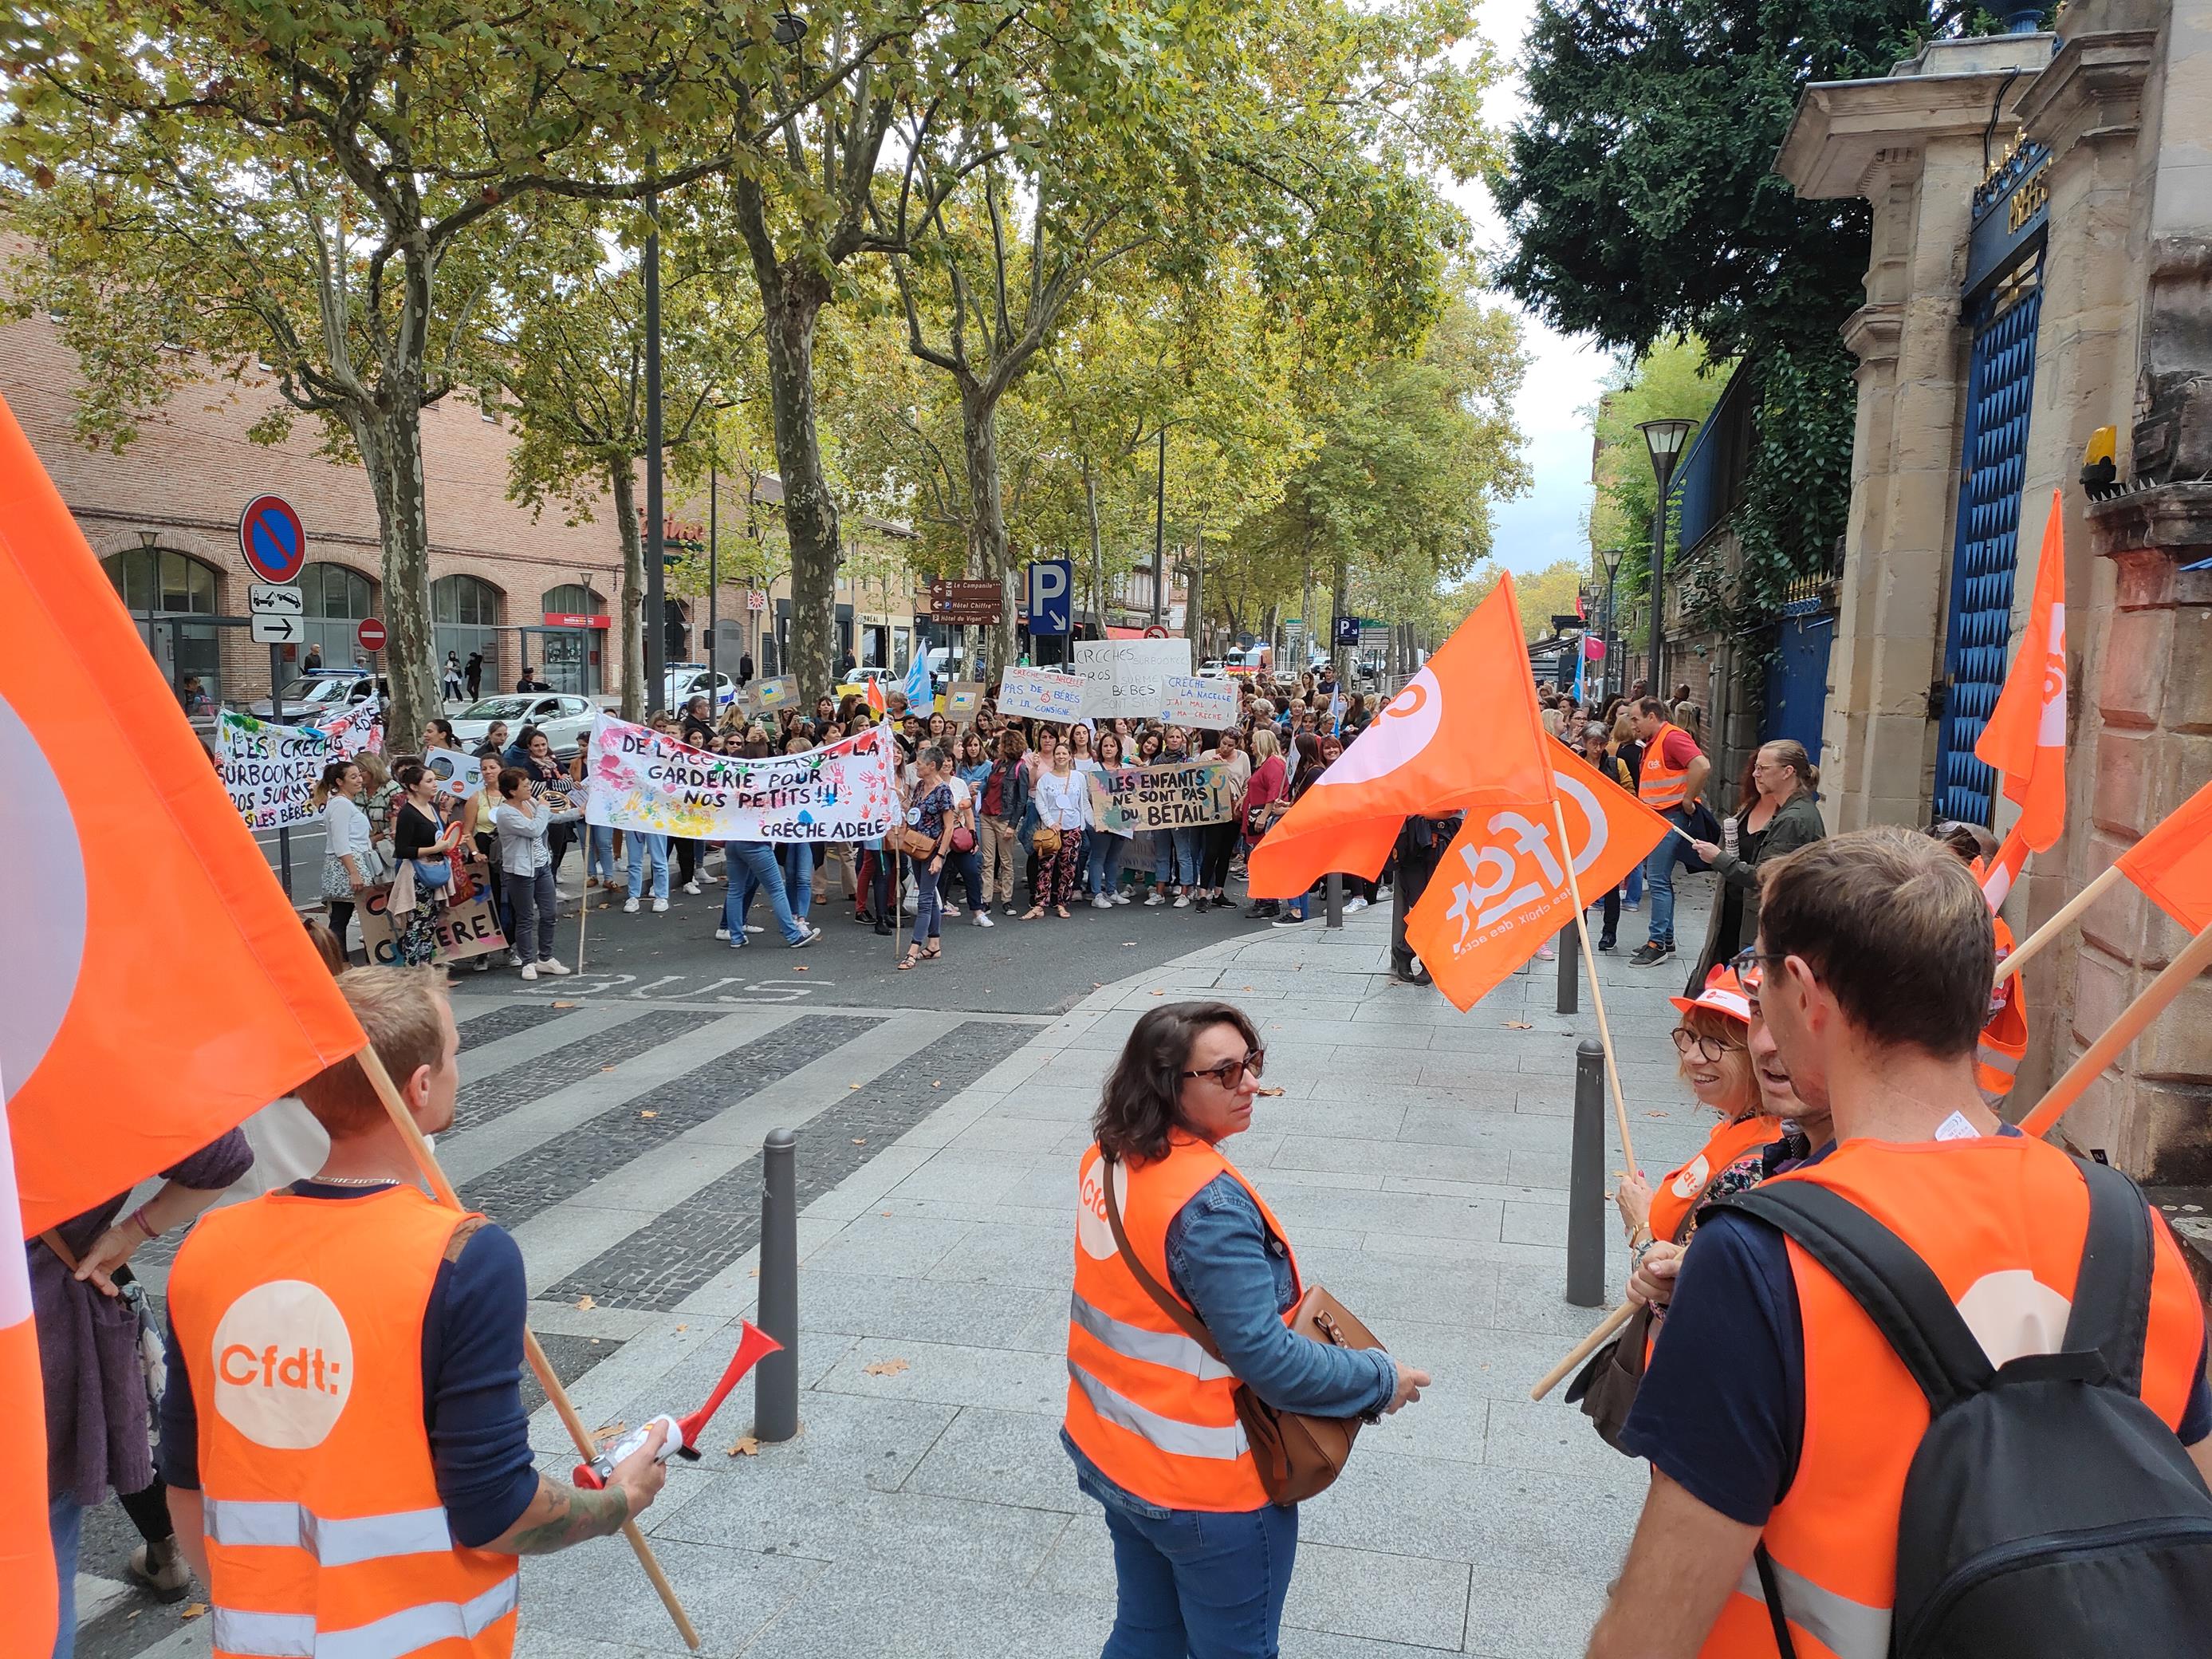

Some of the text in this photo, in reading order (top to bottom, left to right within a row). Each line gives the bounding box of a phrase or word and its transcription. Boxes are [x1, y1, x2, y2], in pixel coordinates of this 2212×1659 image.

[1033, 565, 1066, 617] P
[1340, 621, 1350, 635] P
[1003, 683, 1024, 695] PAS
[1030, 684, 1043, 693] DE
[1168, 676, 1206, 689] CRÈCHE
[1132, 696, 1161, 709] SACR
[1180, 688, 1231, 703] LA NACELLE
[232, 732, 270, 759] LES
[622, 734, 647, 755] DE
[852, 740, 880, 756] LA
[648, 765, 823, 789] GARDERIE POUR
[1108, 768, 1206, 794] LES ENFANTS
[683, 790, 727, 808] NOS
[1112, 786, 1208, 806] NE SONT PAS
[1121, 808, 1139, 822] DU
[761, 818, 886, 838] CRÈCHE ADELE
[513, 973, 836, 1003] BUS
[219, 1343, 340, 1396] Cfdt:
